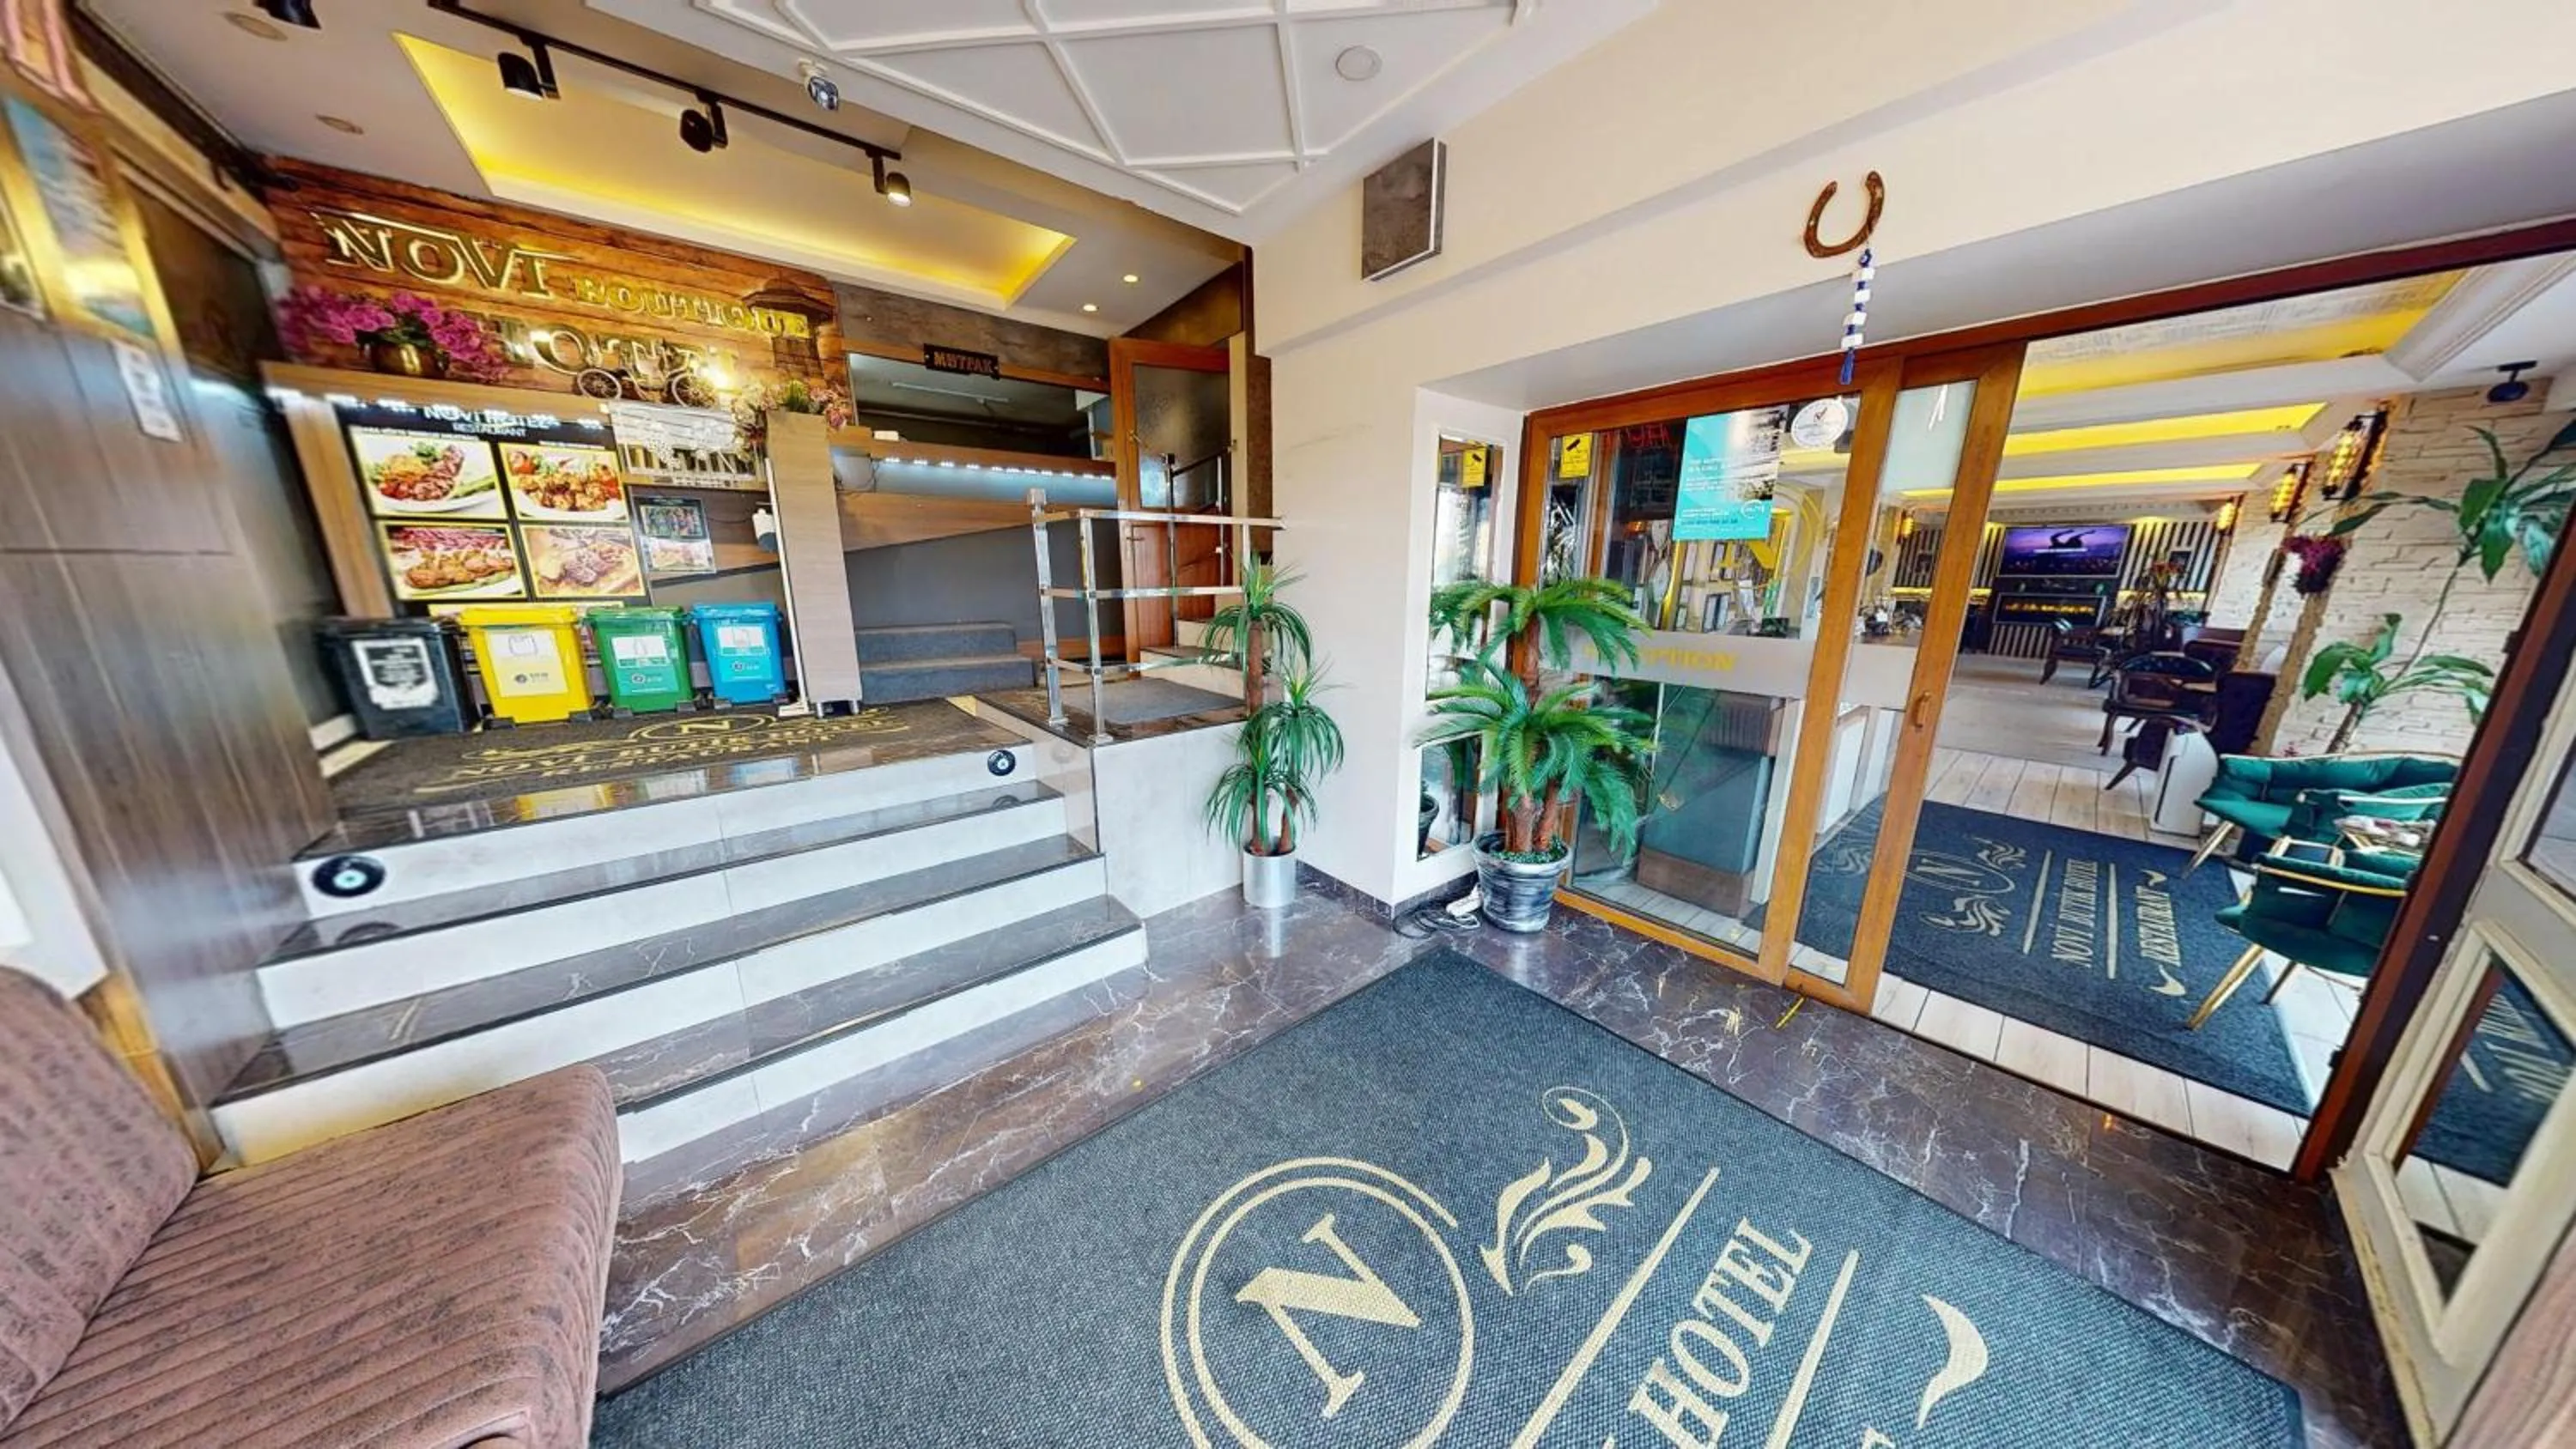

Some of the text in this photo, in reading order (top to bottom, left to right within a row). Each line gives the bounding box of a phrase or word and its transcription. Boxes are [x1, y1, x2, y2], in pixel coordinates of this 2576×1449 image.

[574, 274, 811, 338] BOUTIQUE
[1234, 1212, 1420, 1418] N
[1628, 1217, 1814, 1449] HOTEL
